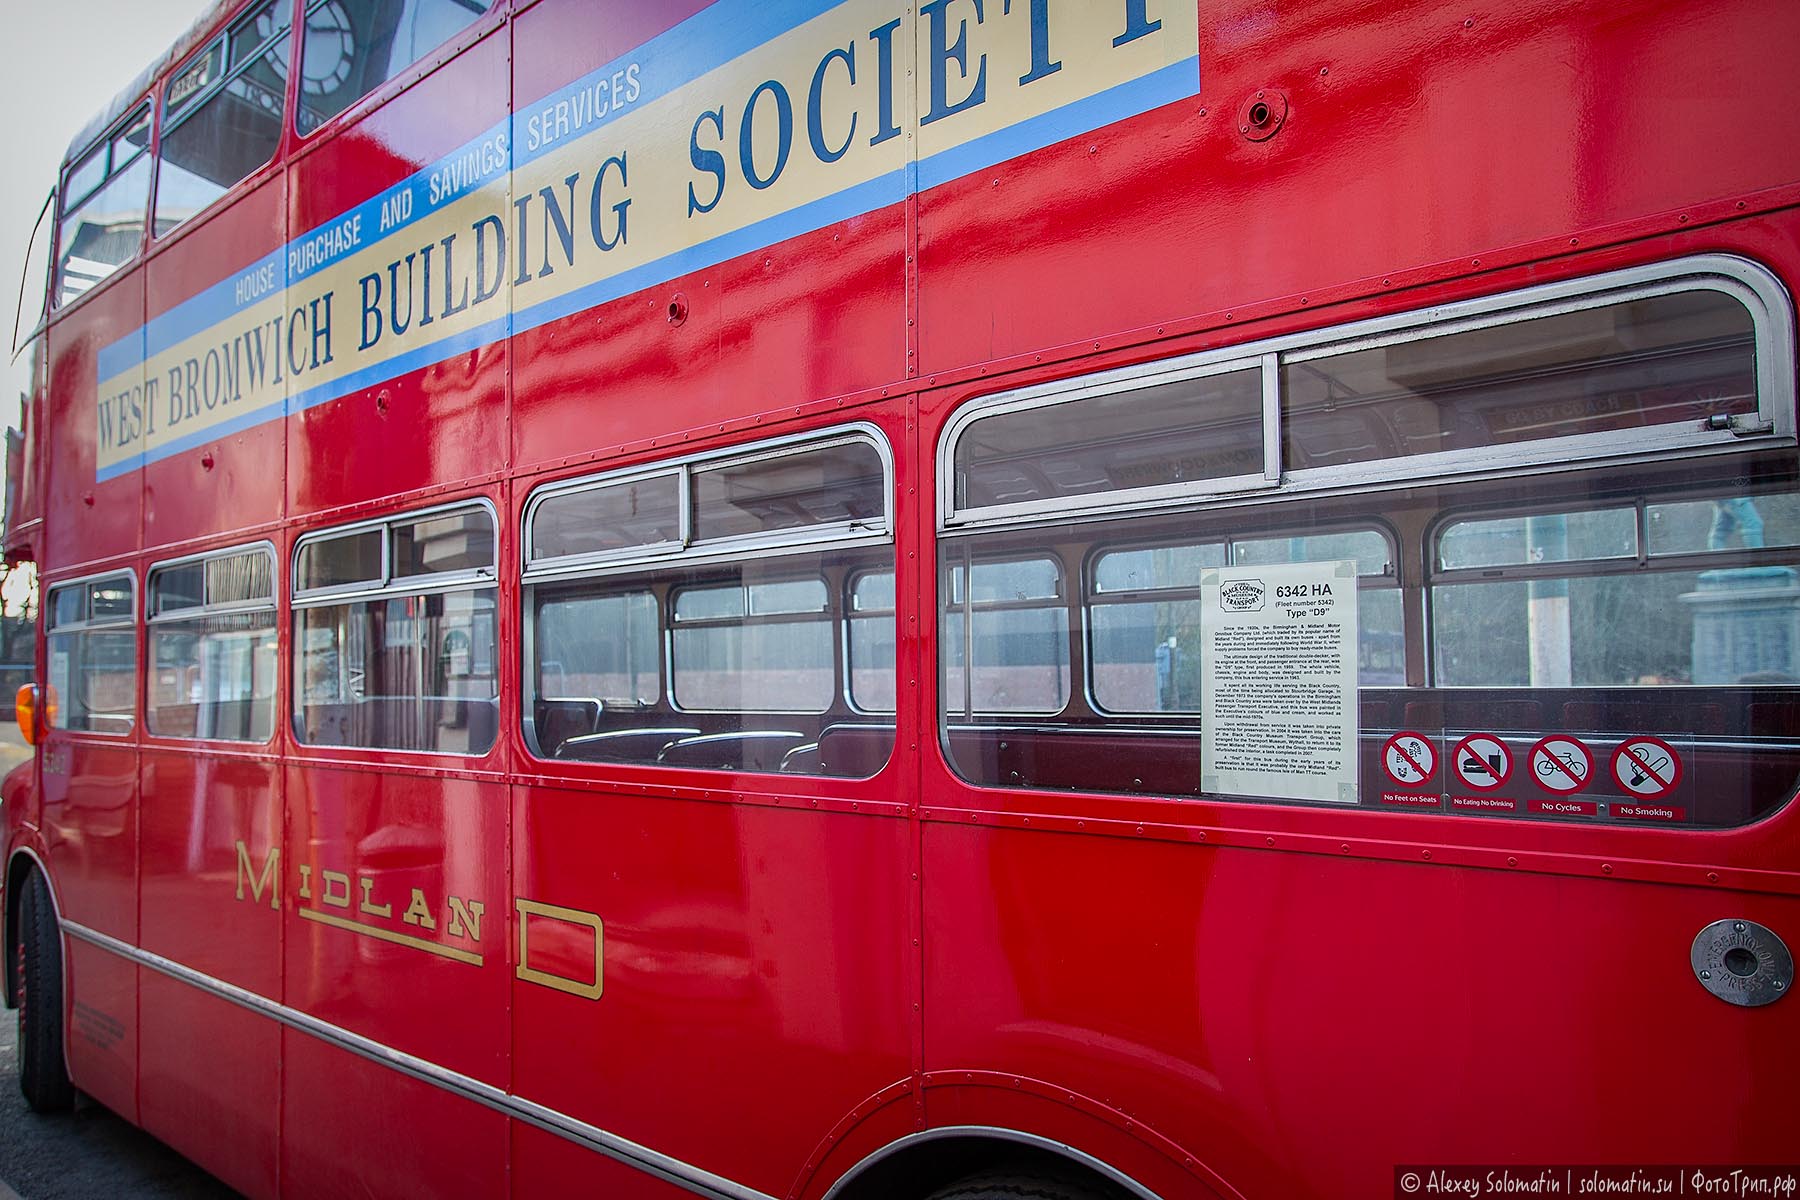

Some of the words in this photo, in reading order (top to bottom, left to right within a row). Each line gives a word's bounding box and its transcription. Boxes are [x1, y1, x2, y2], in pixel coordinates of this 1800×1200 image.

[235, 261, 275, 307] HOUSE
[288, 215, 362, 278] PURCHASE
[380, 187, 413, 233] AND
[429, 134, 507, 204] SAVINGS
[527, 63, 642, 151] SERVICES
[97, 379, 160, 453] WEST
[167, 290, 334, 426] BROMWICH
[358, 150, 631, 352] BUILDING
[1222, 586, 1239, 597] BLACK
[1239, 585, 1264, 595] COUNTRY
[1276, 585, 1307, 597] 6342
[1312, 584, 1332, 596] HA
[1226, 595, 1260, 606] TRANSPORT
[1286, 610, 1307, 618] Type
[1394, 794, 1409, 802] Feet
[1463, 798, 1480, 807] Eating
[1490, 800, 1514, 808] Drinking
[1542, 803, 1554, 811] No
[1555, 803, 1582, 813] Cycles
[1635, 807, 1673, 818] Smoking
[1706, 932, 1762, 970] EMERGENCY
[1758, 951, 1776, 981] ONLY
